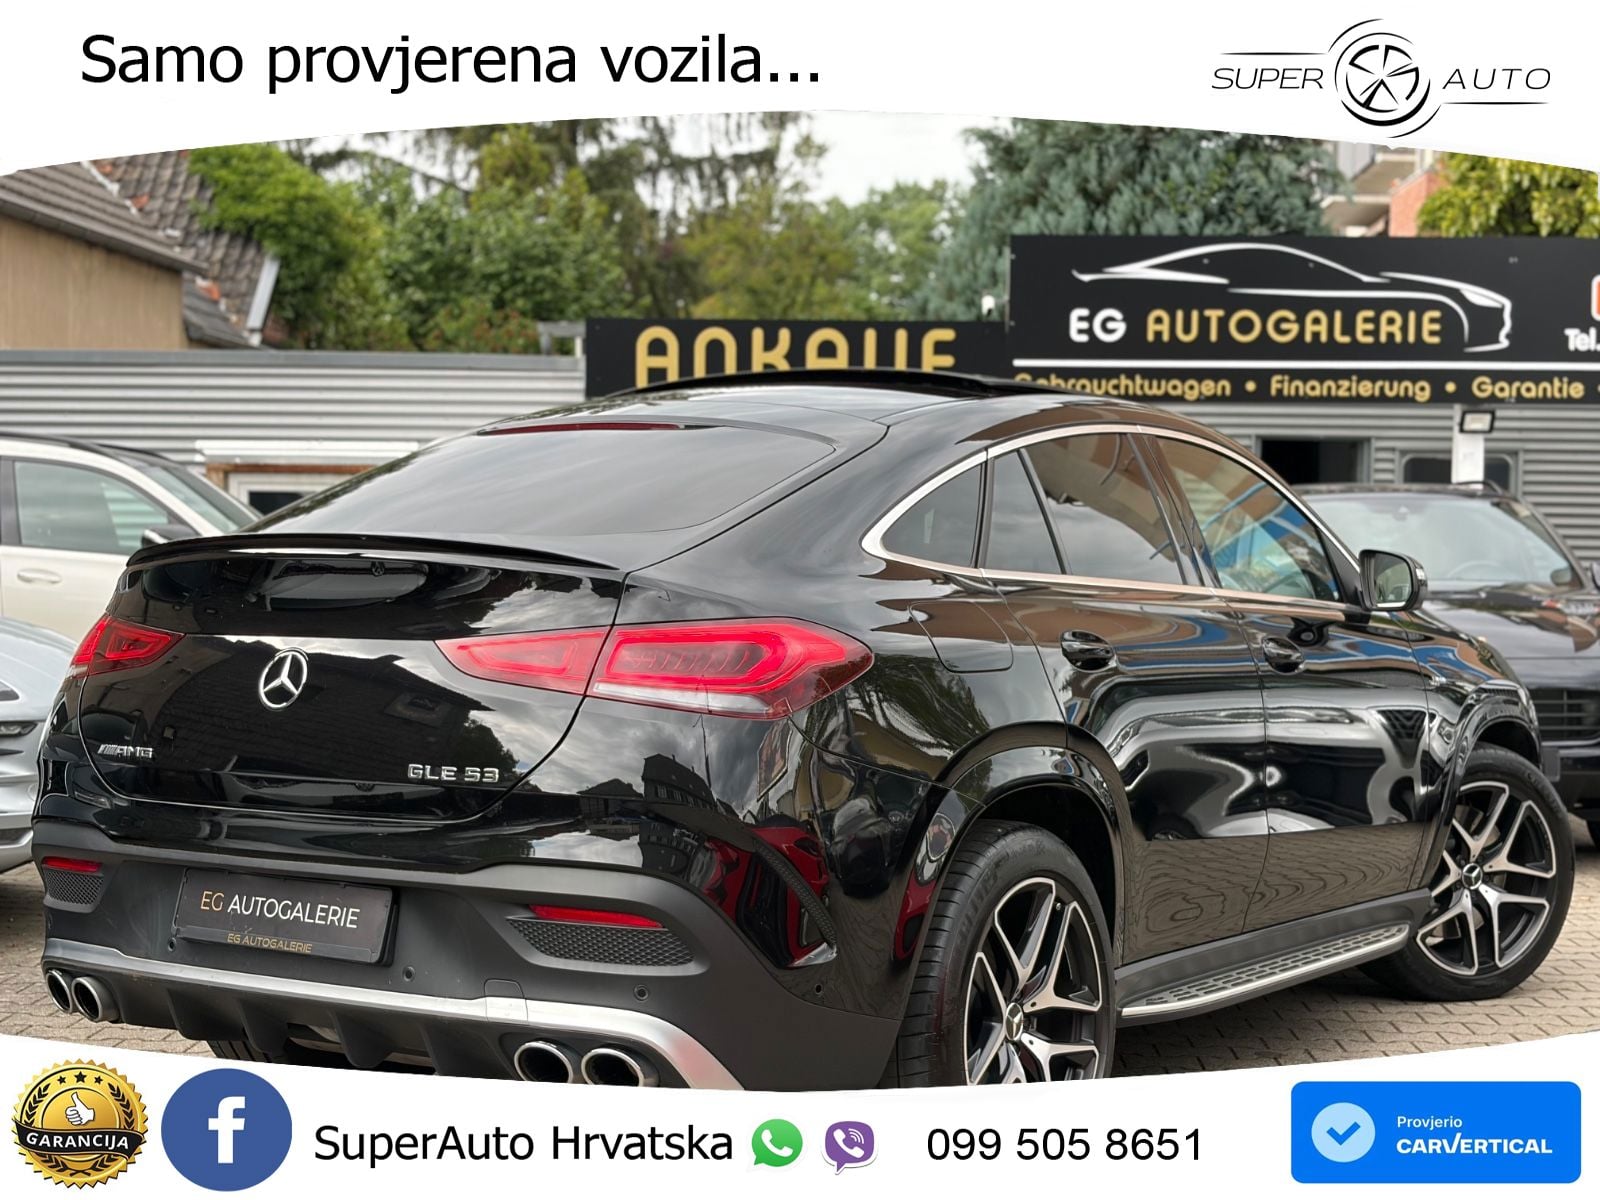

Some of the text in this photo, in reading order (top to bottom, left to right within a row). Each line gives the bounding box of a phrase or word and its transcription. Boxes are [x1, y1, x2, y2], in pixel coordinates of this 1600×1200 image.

[1069, 307, 1443, 344] EG AUTOGALERIE
[1269, 375, 1431, 402] Finanzierung
[1471, 375, 1586, 399] Garantie
[407, 763, 500, 783] GLE 53
[200, 890, 361, 929] EG AUTOGALERIE
[226, 933, 313, 953] EG AUTOGALERIE
